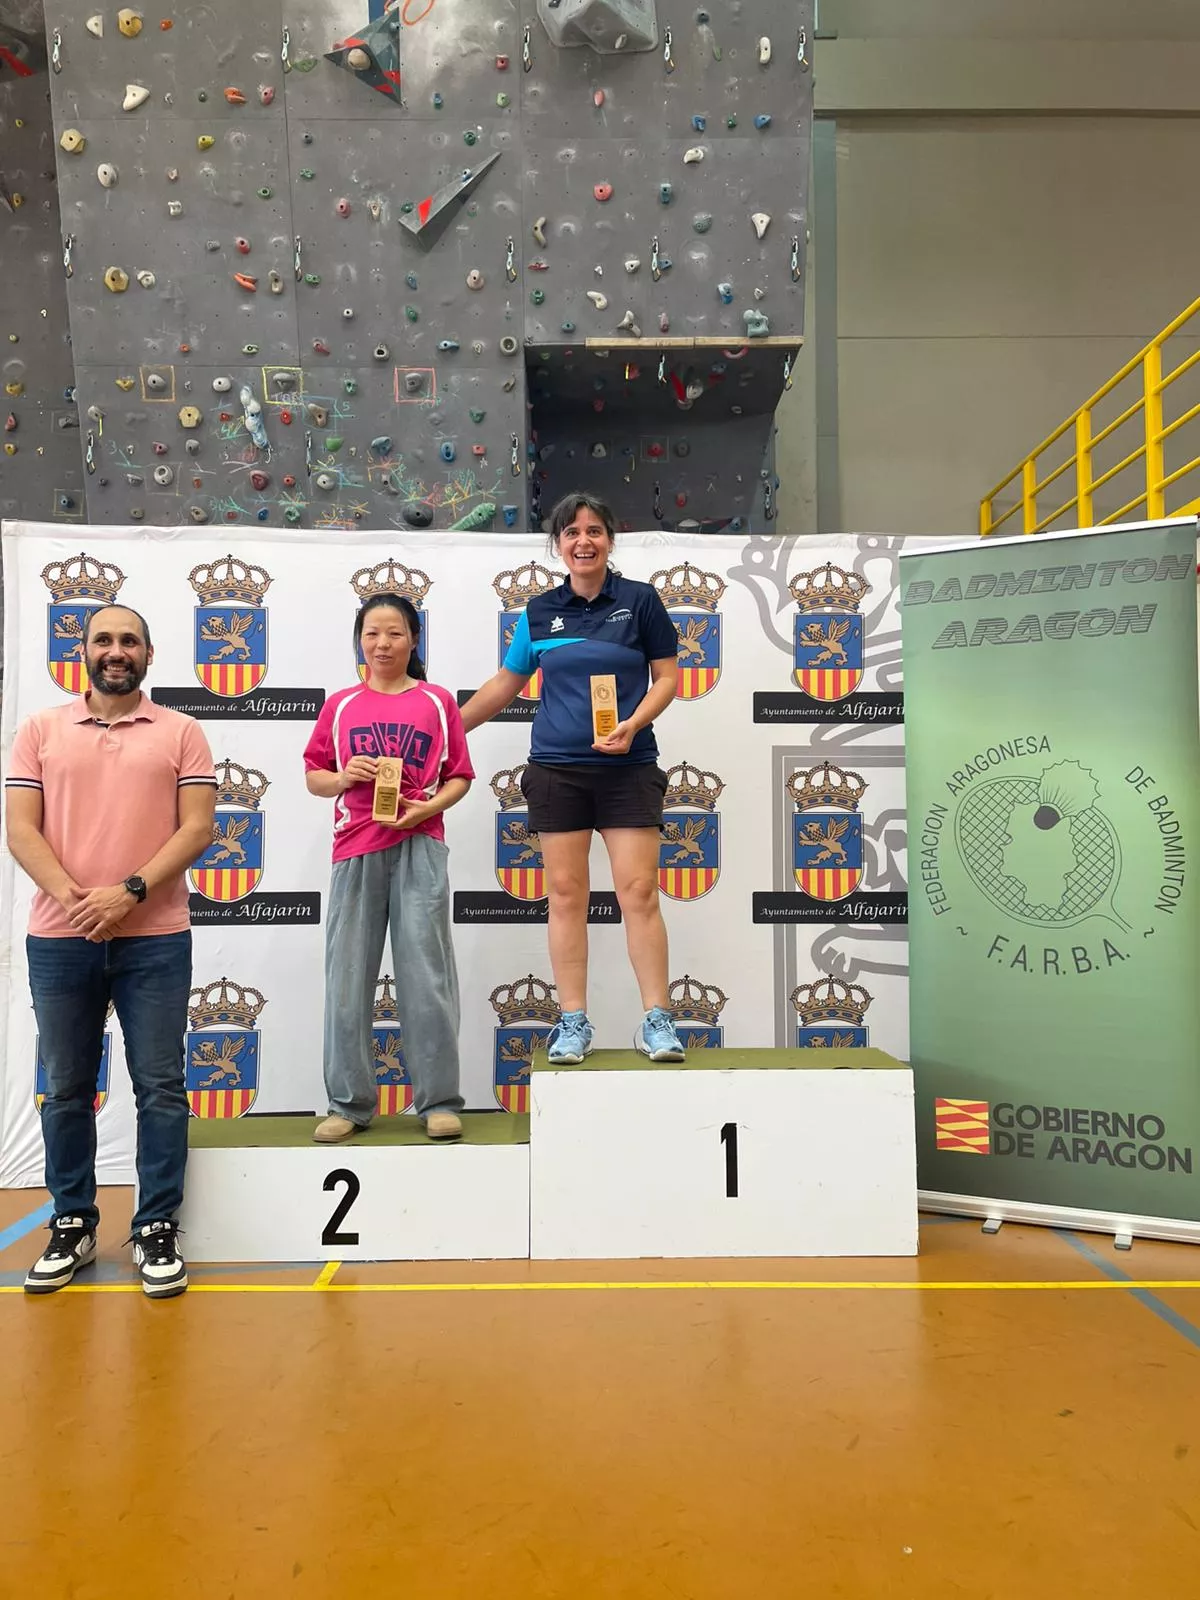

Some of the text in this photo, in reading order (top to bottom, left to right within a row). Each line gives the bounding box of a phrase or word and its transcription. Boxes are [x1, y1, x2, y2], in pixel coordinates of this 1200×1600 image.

[903, 553, 1194, 607] BADMINTON
[931, 603, 1158, 650] ARAGON
[227, 703, 237, 711] de
[241, 698, 316, 716] Alfajarín
[760, 707, 824, 718] Ayuntamiento
[825, 707, 836, 716] de
[352, 733, 426, 762] RSL
[921, 735, 1186, 916] FEDERACION ARAGONESA DE BADMINTON
[221, 907, 233, 917] de
[235, 902, 312, 921] Alfajarín
[460, 907, 525, 919] Ayuntamiento
[526, 907, 537, 915] de
[760, 907, 824, 918] Ayuntamiento
[825, 907, 837, 916] de
[993, 1102, 1166, 1141] GOBIERNO
[720, 1122, 738, 1198] 1
[993, 1131, 1192, 1174] DE ARAGON
[321, 1168, 360, 1246] 2
